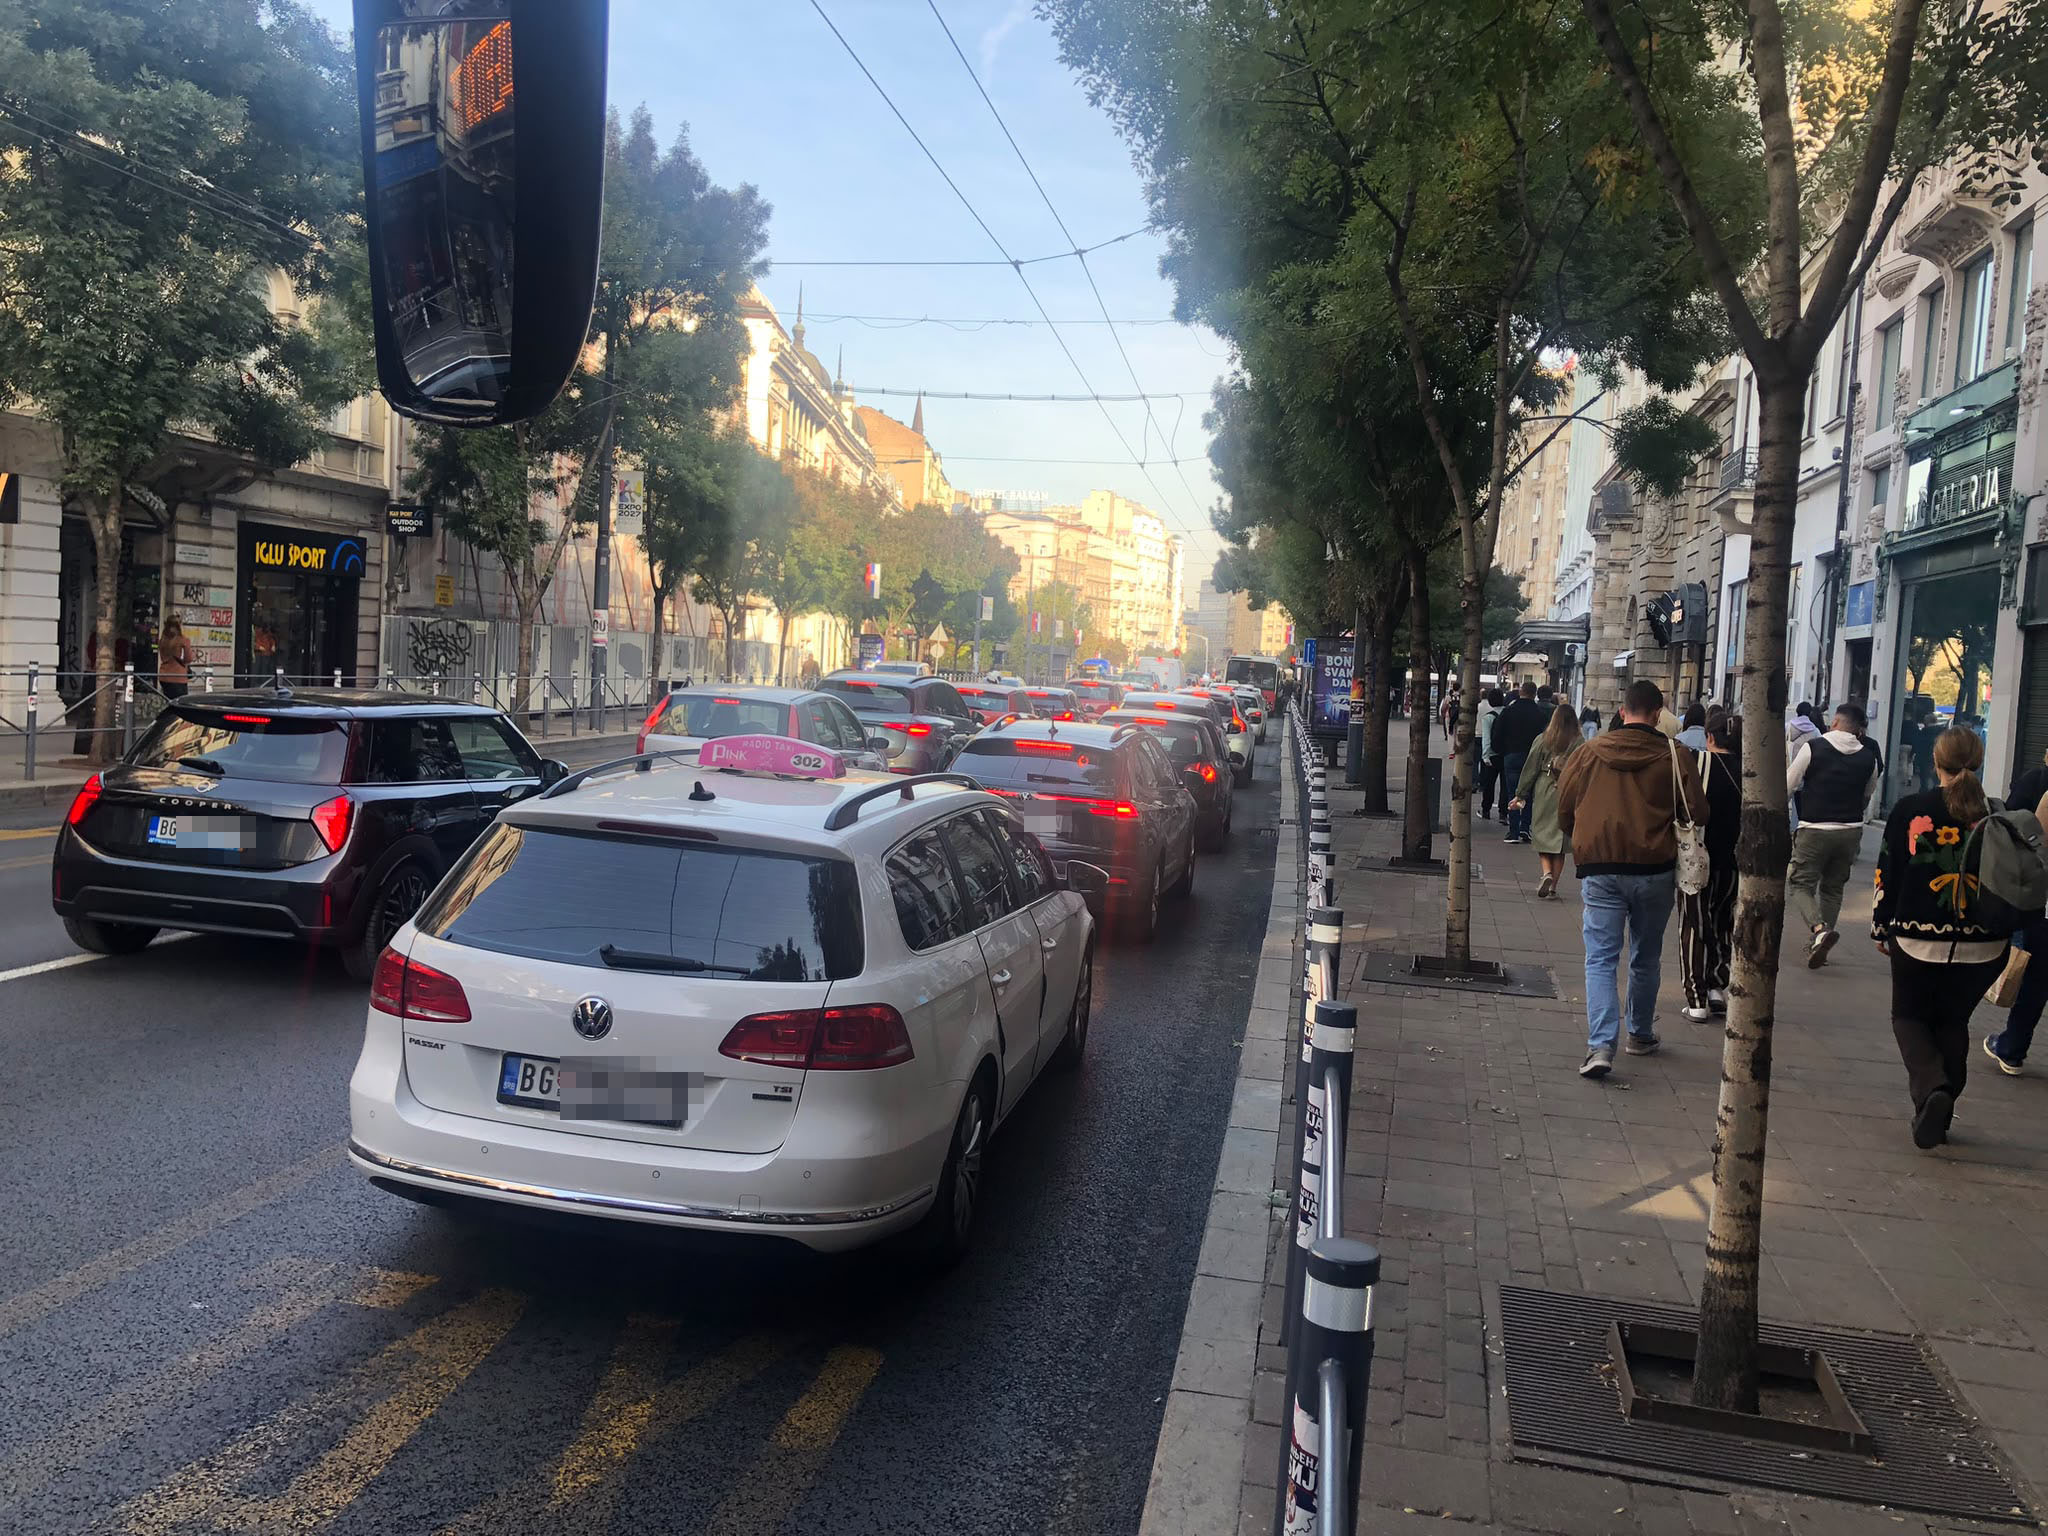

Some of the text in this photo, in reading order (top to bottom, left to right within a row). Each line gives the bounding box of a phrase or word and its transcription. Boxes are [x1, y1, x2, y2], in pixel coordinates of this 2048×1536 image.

[1931, 466, 1999, 525] GALERIJA
[618, 503, 642, 511] EXPO
[391, 518, 424, 527] OUTDOOR
[398, 525, 417, 533] SHOP
[255, 541, 284, 566] IGLU
[742, 739, 795, 752] RADIO TAXI
[712, 744, 747, 762] PINK
[792, 755, 822, 768] 302
[159, 797, 232, 810] COOPER
[408, 1037, 446, 1050] PASSAT
[773, 1085, 793, 1094] TSI
